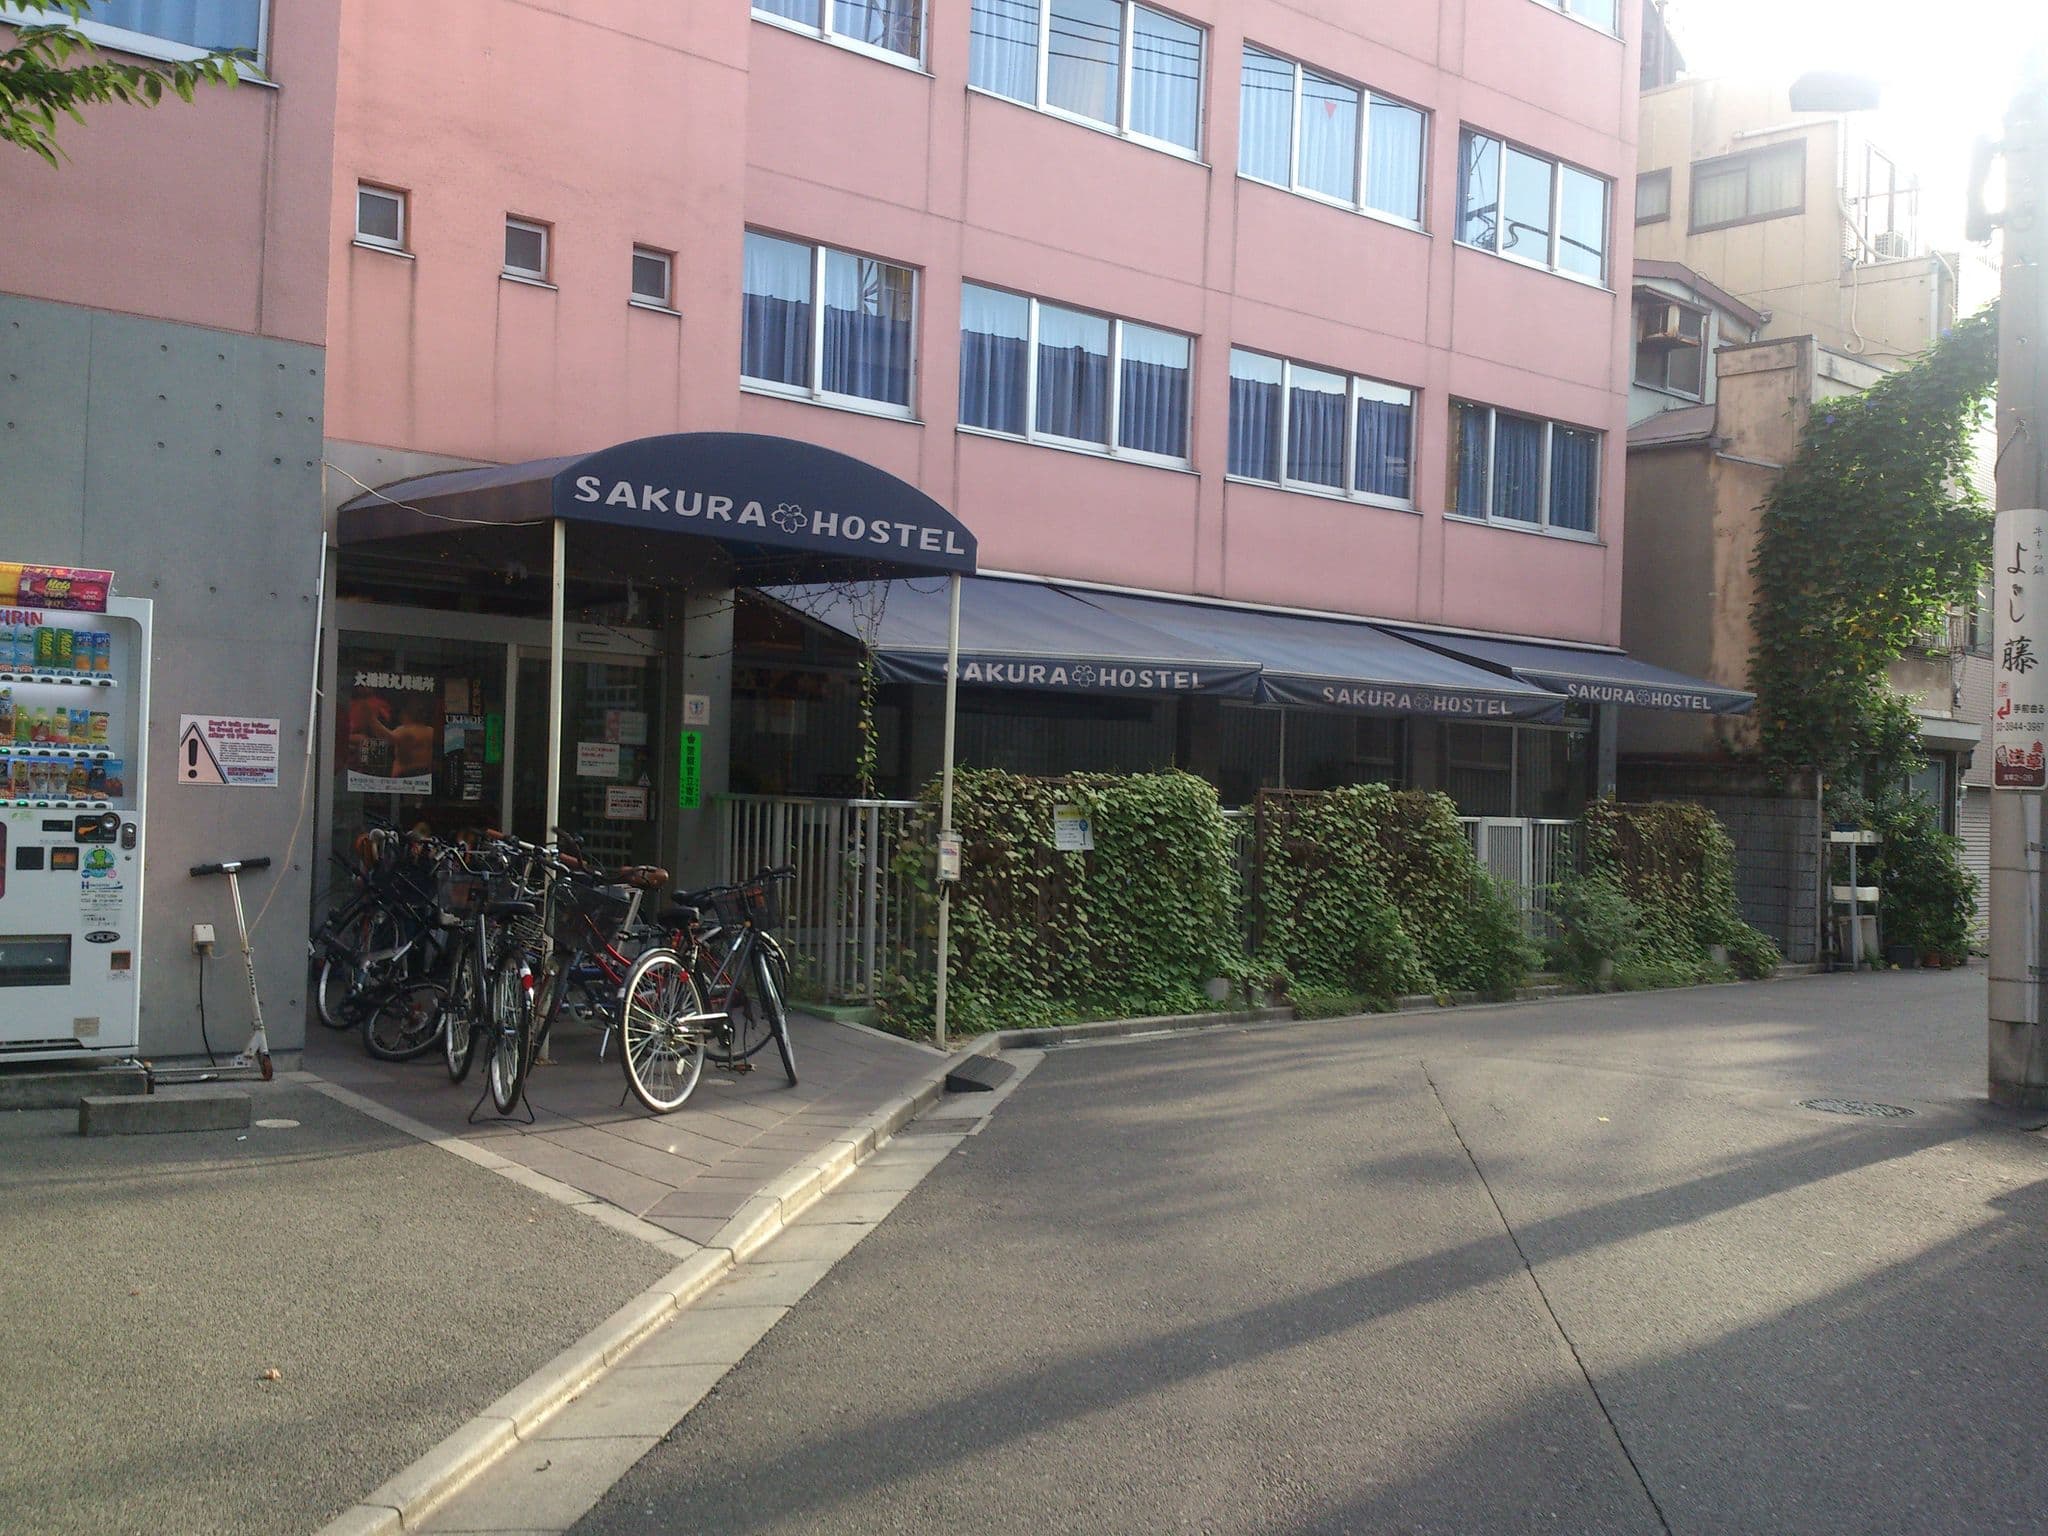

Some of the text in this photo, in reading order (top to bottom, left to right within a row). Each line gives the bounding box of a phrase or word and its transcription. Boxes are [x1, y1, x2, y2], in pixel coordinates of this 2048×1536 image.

[574, 475, 965, 555] SAKURA HOSTEL
[1100, 667, 1205, 690] HOSTEL
[1322, 686, 1513, 715] SAKURA HOSTEL
[1567, 683, 1712, 711] SAKURA HOSTEL
